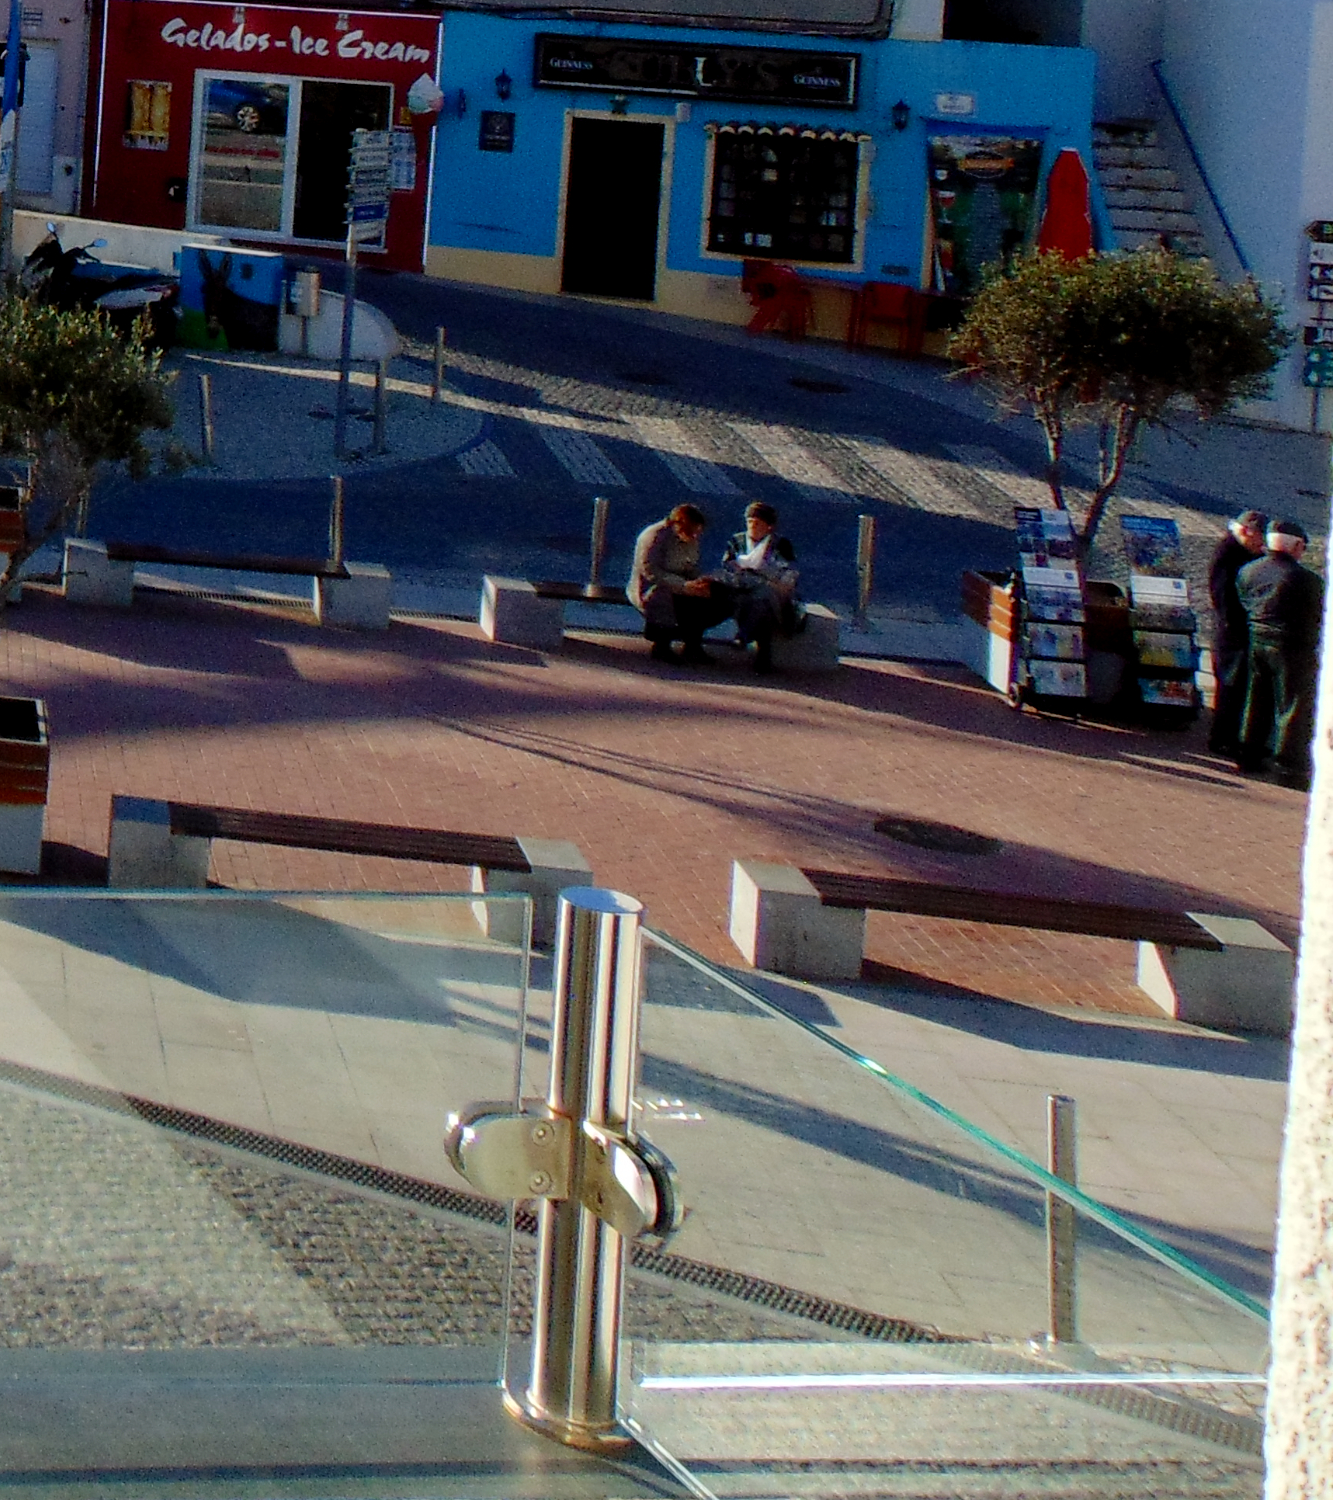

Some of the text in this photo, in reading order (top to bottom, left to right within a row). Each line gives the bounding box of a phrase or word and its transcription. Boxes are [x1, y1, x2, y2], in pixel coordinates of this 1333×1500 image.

[161, 17, 271, 53] Gelados
[290, 25, 330, 57] Ice
[337, 29, 430, 64] Cream
[548, 56, 594, 71] GUINNESS
[793, 73, 842, 88] GUINNESS
